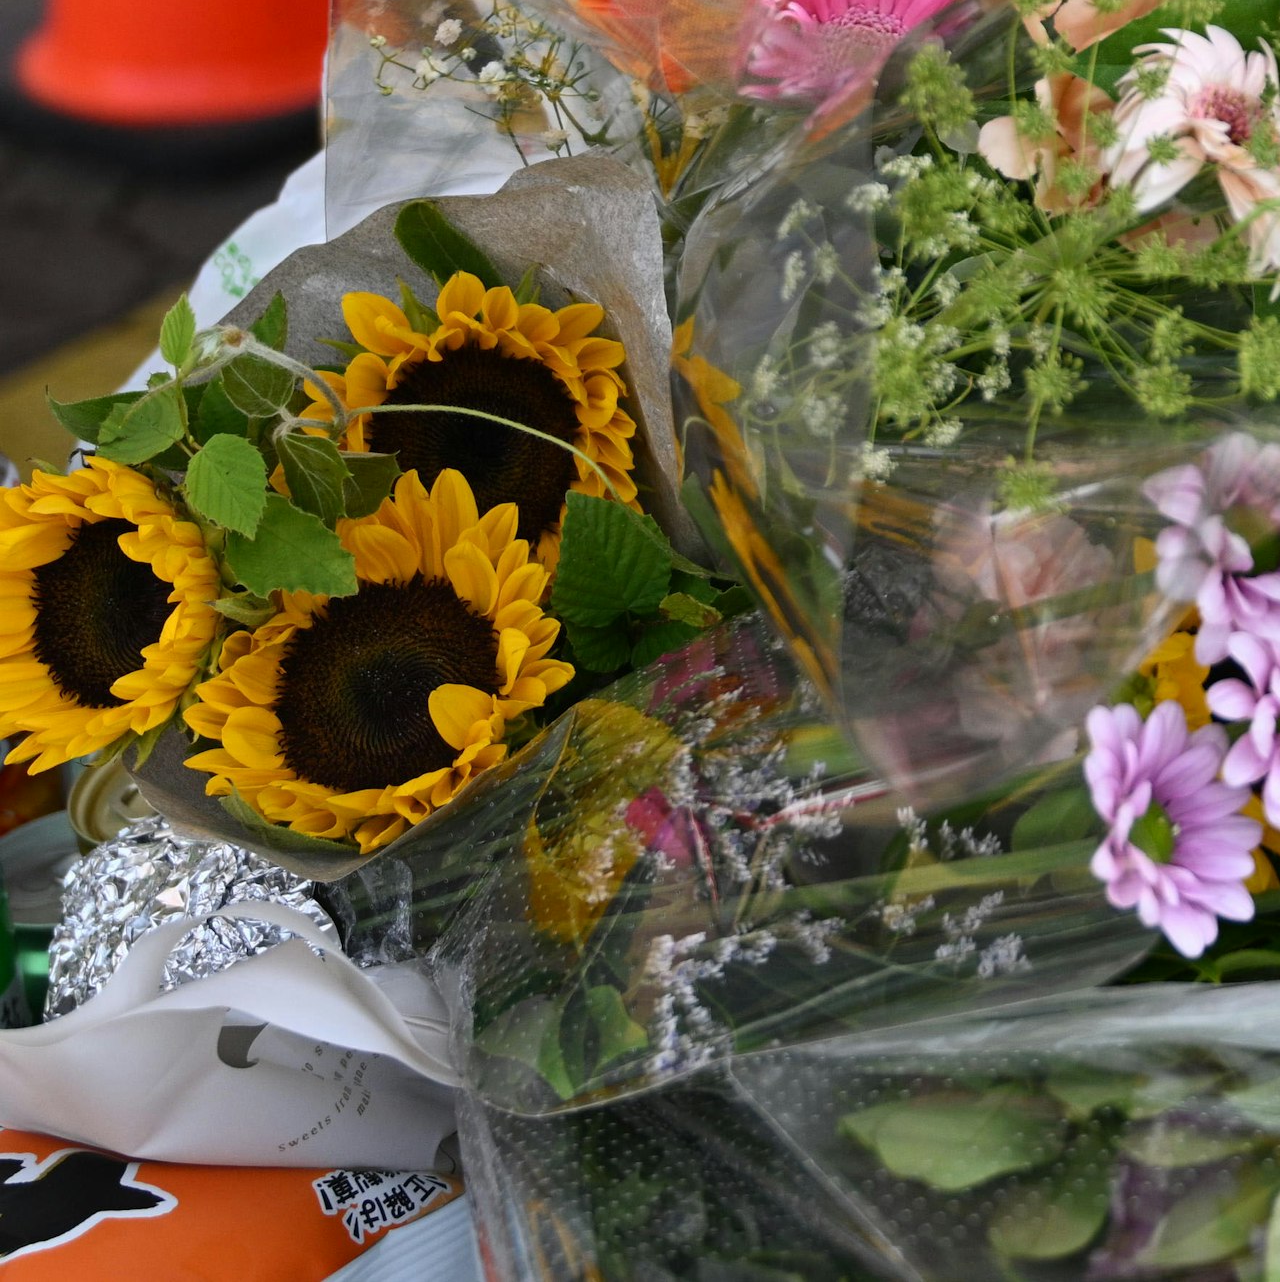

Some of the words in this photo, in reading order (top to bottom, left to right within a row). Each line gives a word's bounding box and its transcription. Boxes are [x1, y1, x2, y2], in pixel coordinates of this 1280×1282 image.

[278, 1114, 332, 1152] sweets
[360, 1173, 437, 1229] 正解は
